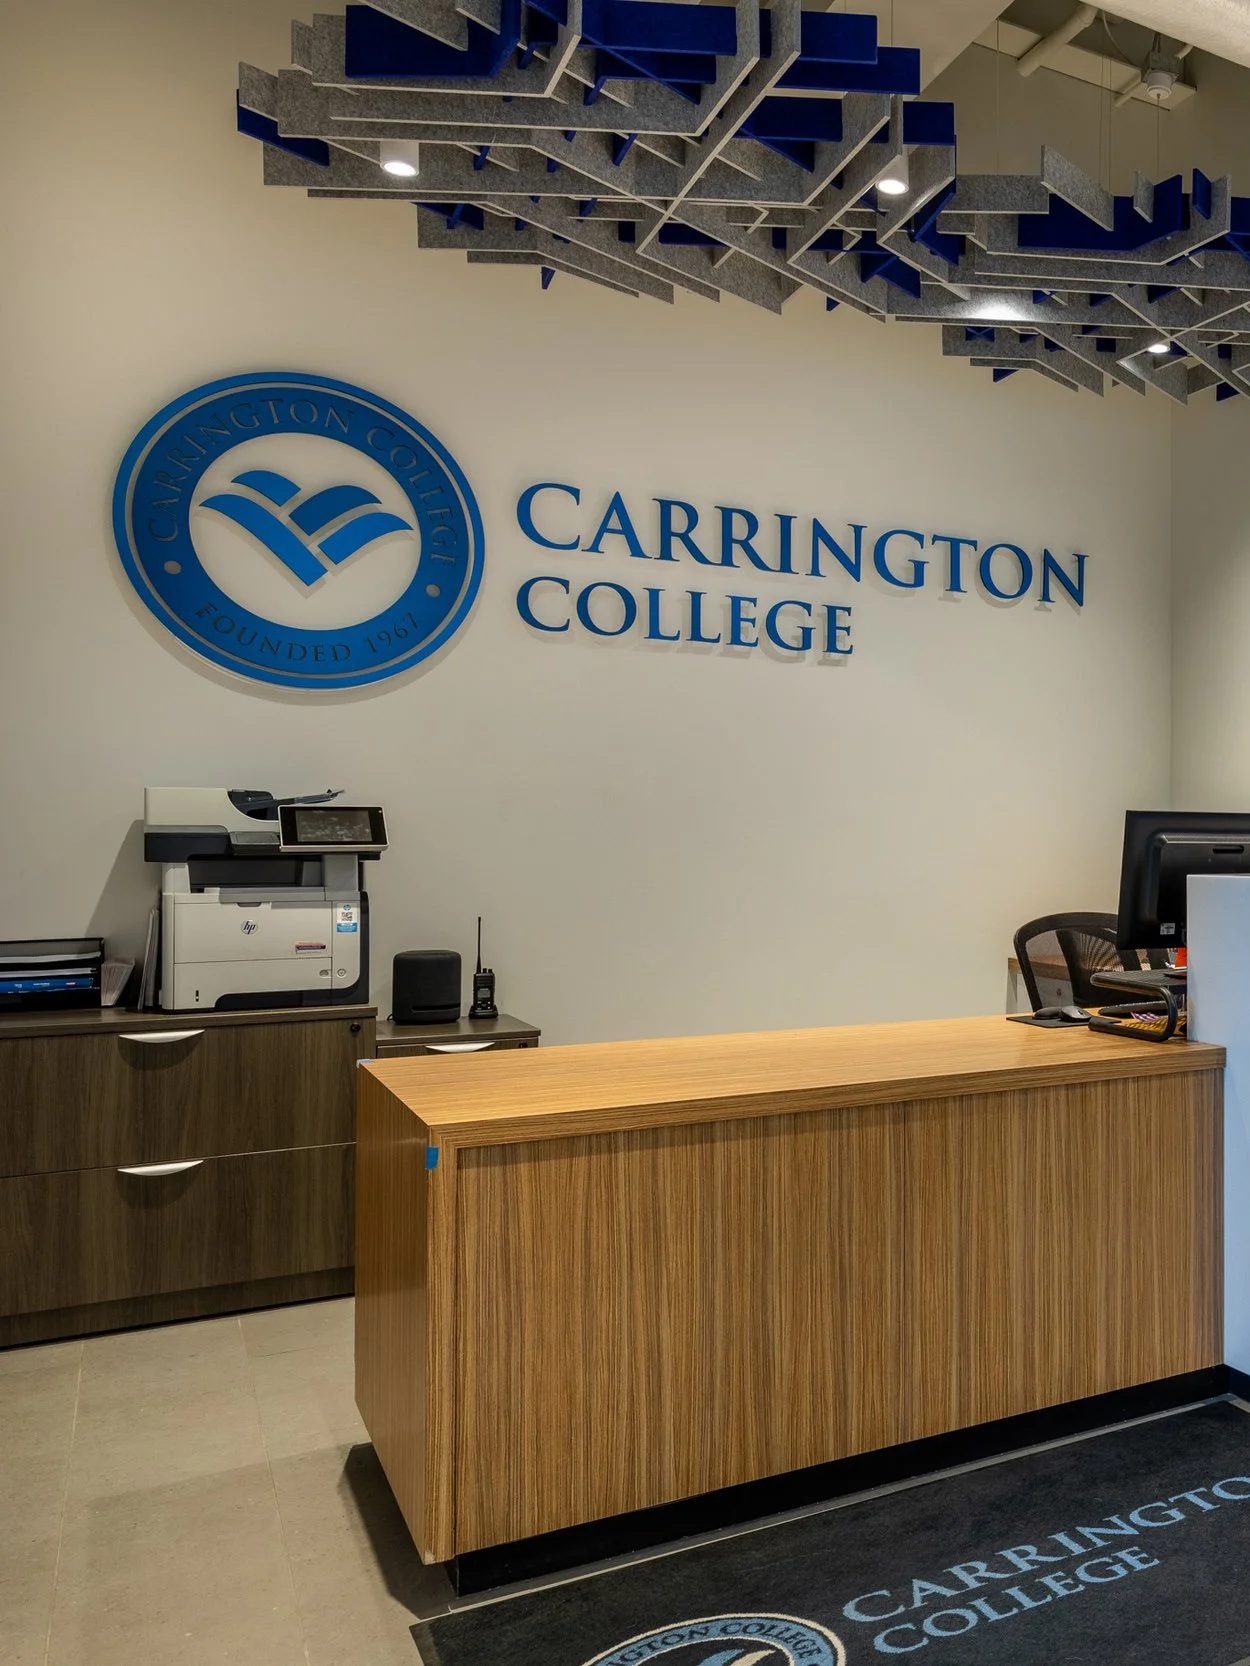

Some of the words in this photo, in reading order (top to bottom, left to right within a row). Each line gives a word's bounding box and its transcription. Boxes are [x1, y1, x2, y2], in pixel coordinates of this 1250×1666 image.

[149, 397, 355, 543] CARRINGTON
[366, 425, 460, 570] COLLEGE
[516, 482, 1090, 607] CARRINGTON
[195, 600, 352, 663] FOUNDED
[365, 611, 421, 655] 1967
[516, 575, 854, 655] COLLEGE
[243, 920, 256, 935] hp
[873, 1546, 1160, 1654] COLLEGE
[719, 1621, 822, 1660] COLLEGE
